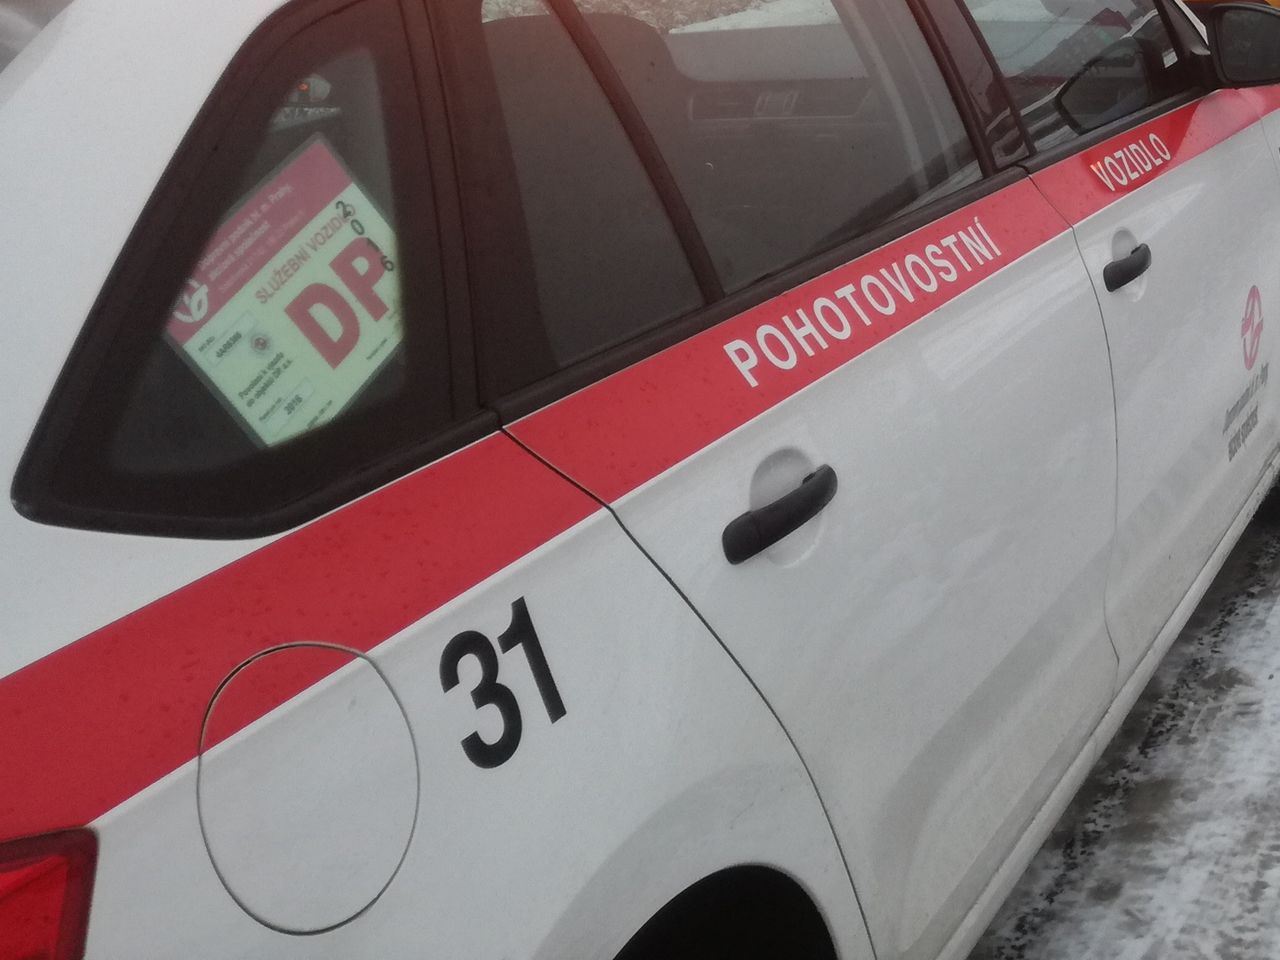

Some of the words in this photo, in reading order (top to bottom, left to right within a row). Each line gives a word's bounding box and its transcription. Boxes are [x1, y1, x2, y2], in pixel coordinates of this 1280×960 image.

[255, 247, 311, 304] SLUŽEBNÍ
[284, 236, 390, 370] DP
[723, 216, 1002, 389] POHOTOVOSTNÍ
[1091, 132, 1172, 193] VOZIDLO
[439, 596, 567, 769] 31
